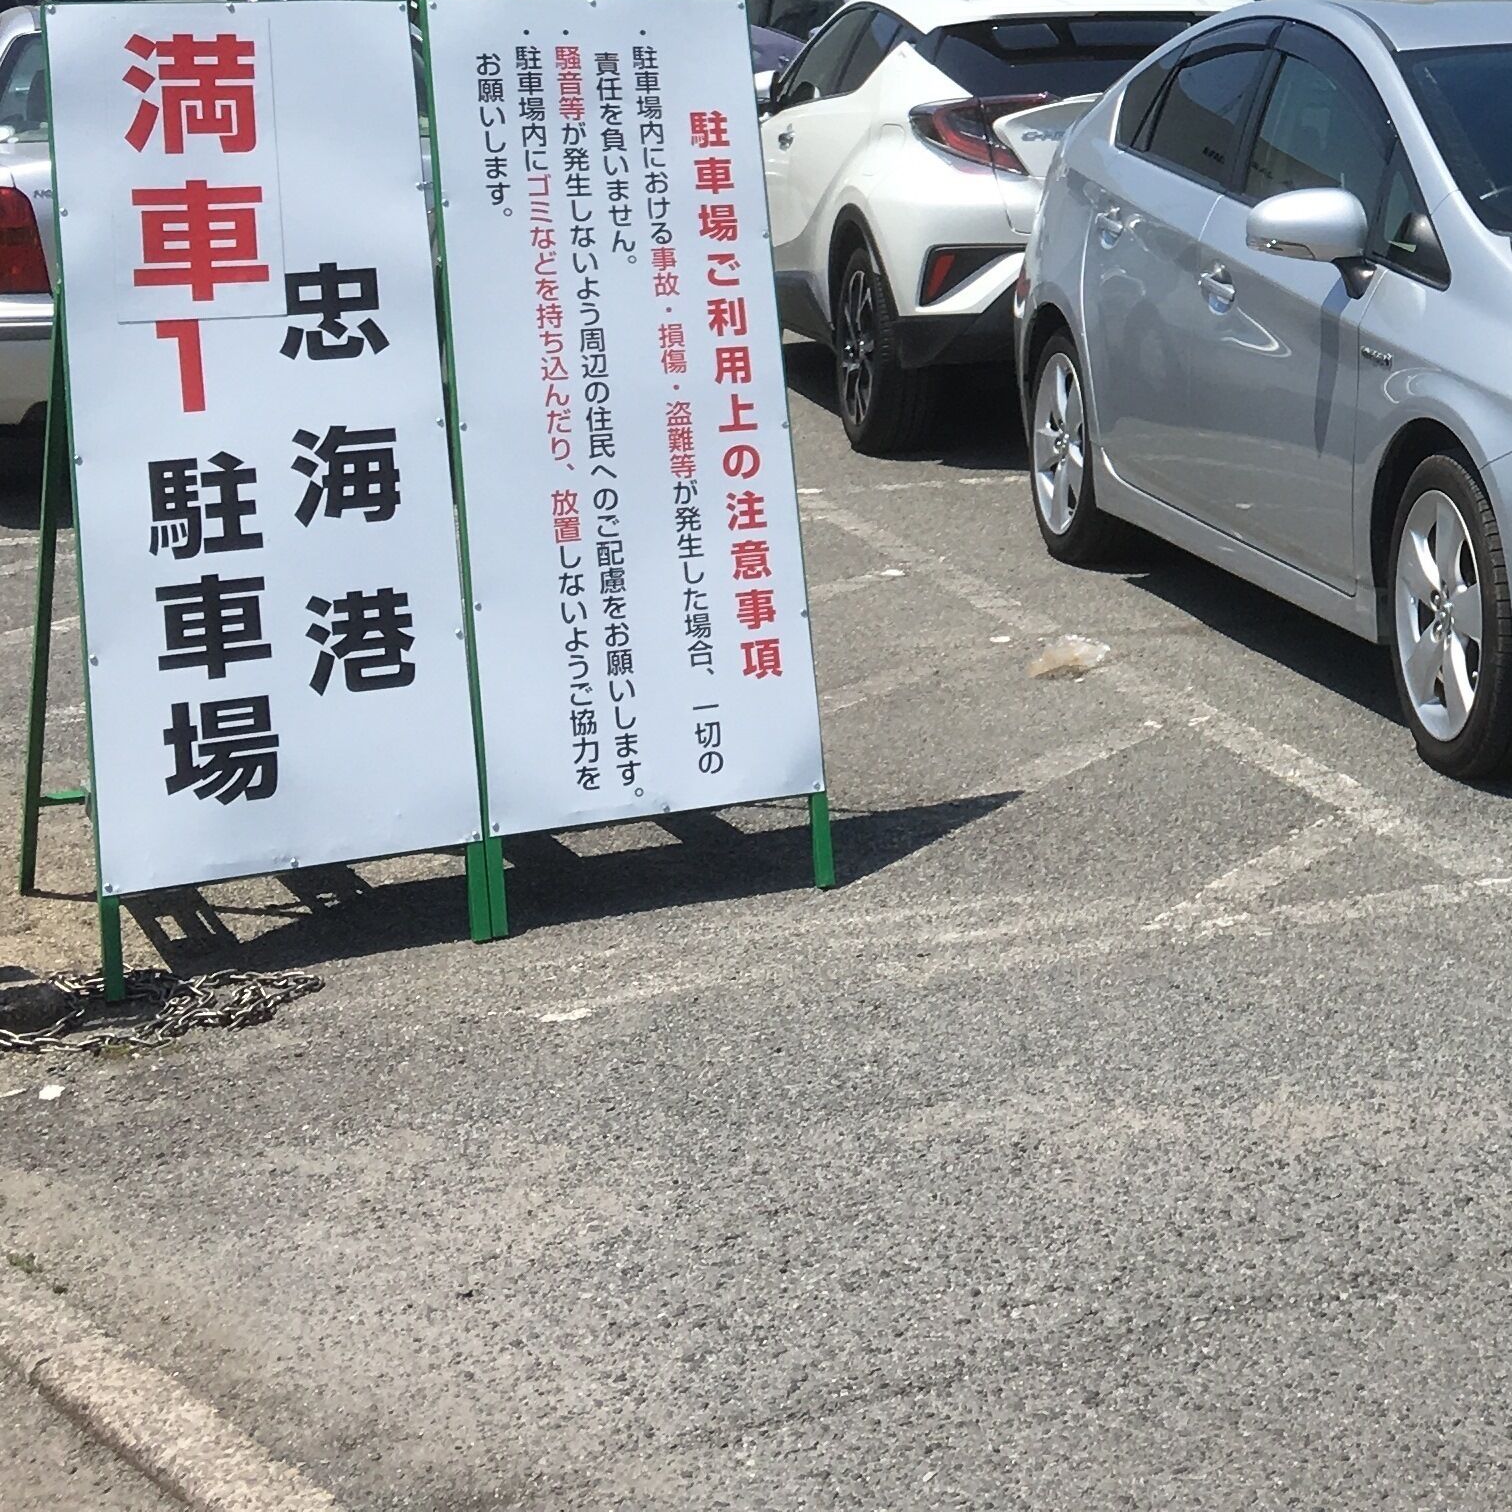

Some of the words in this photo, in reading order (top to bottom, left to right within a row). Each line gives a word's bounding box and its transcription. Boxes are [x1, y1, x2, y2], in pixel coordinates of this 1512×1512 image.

[122, 34, 269, 301] 満車
[476, 53, 512, 216] お願いします。
[594, 52, 636, 264] 責任を負いません。
[280, 262, 415, 696] 忠海港
[690, 111, 782, 679] 駐車場ご利用上の注意事項
